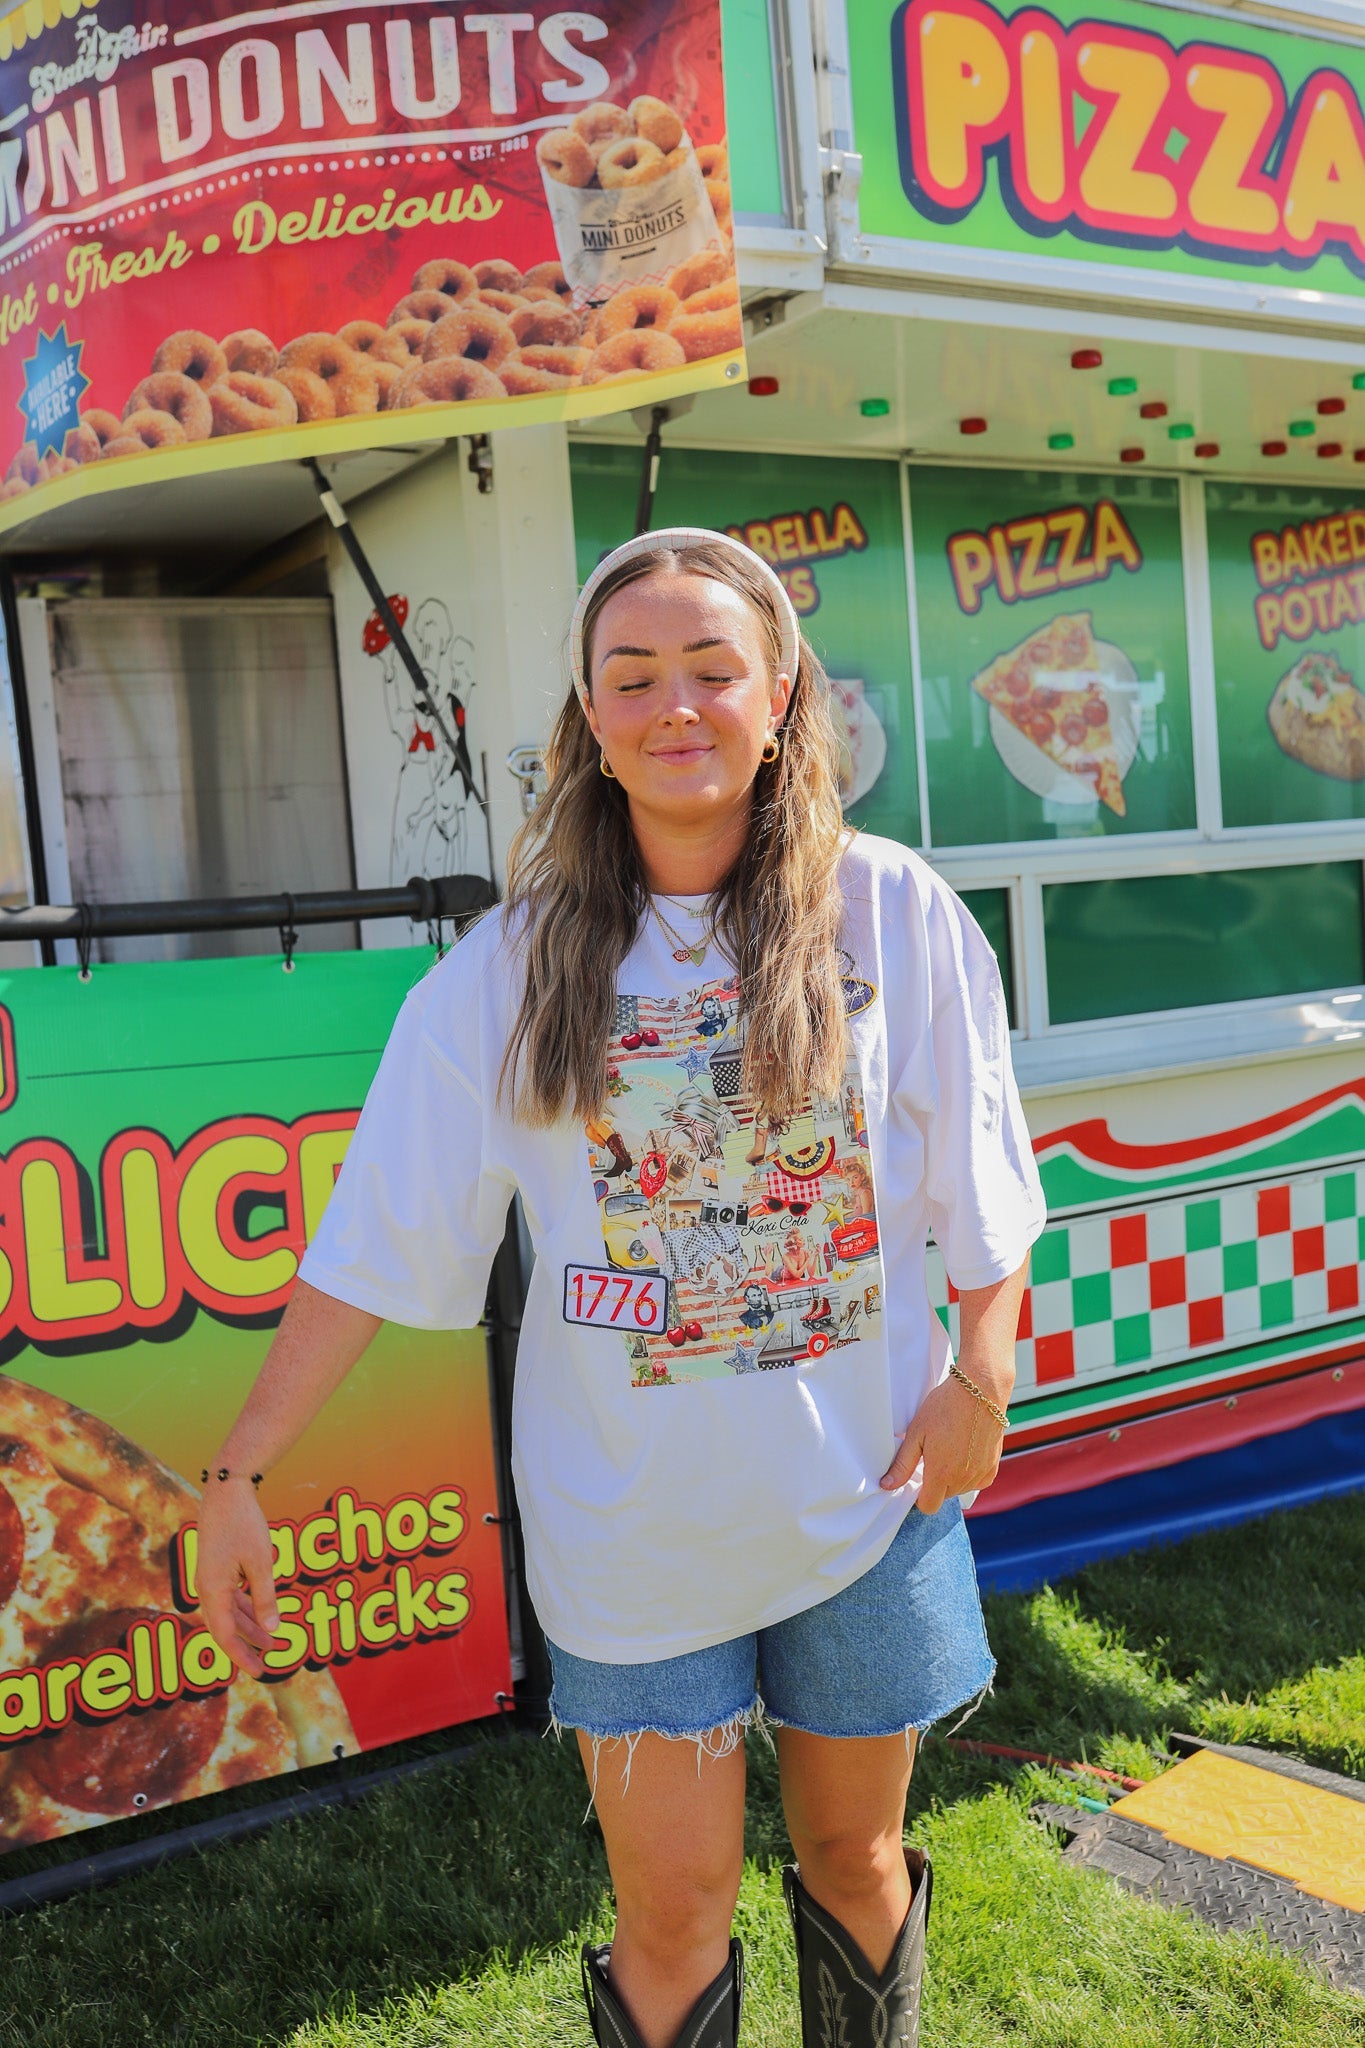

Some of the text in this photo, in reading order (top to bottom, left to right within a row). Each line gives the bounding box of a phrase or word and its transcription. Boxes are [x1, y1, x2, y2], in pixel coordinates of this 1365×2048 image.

[29, 56, 98, 113] State
[152, 6, 610, 164] DONUTS
[469, 144, 496, 162] EST.
[905, 3, 1365, 256] PIZZA
[63, 230, 193, 308] Fresh
[232, 183, 503, 255] Delicious
[581, 229, 619, 247] MINI
[624, 206, 685, 243] DONUTS
[37, 384, 71, 434] HERE
[948, 501, 1140, 613] PIZZA
[780, 1214, 810, 1231] Cola
[573, 1274, 657, 1326] 1776
[261, 1560, 476, 1674] Sticks
